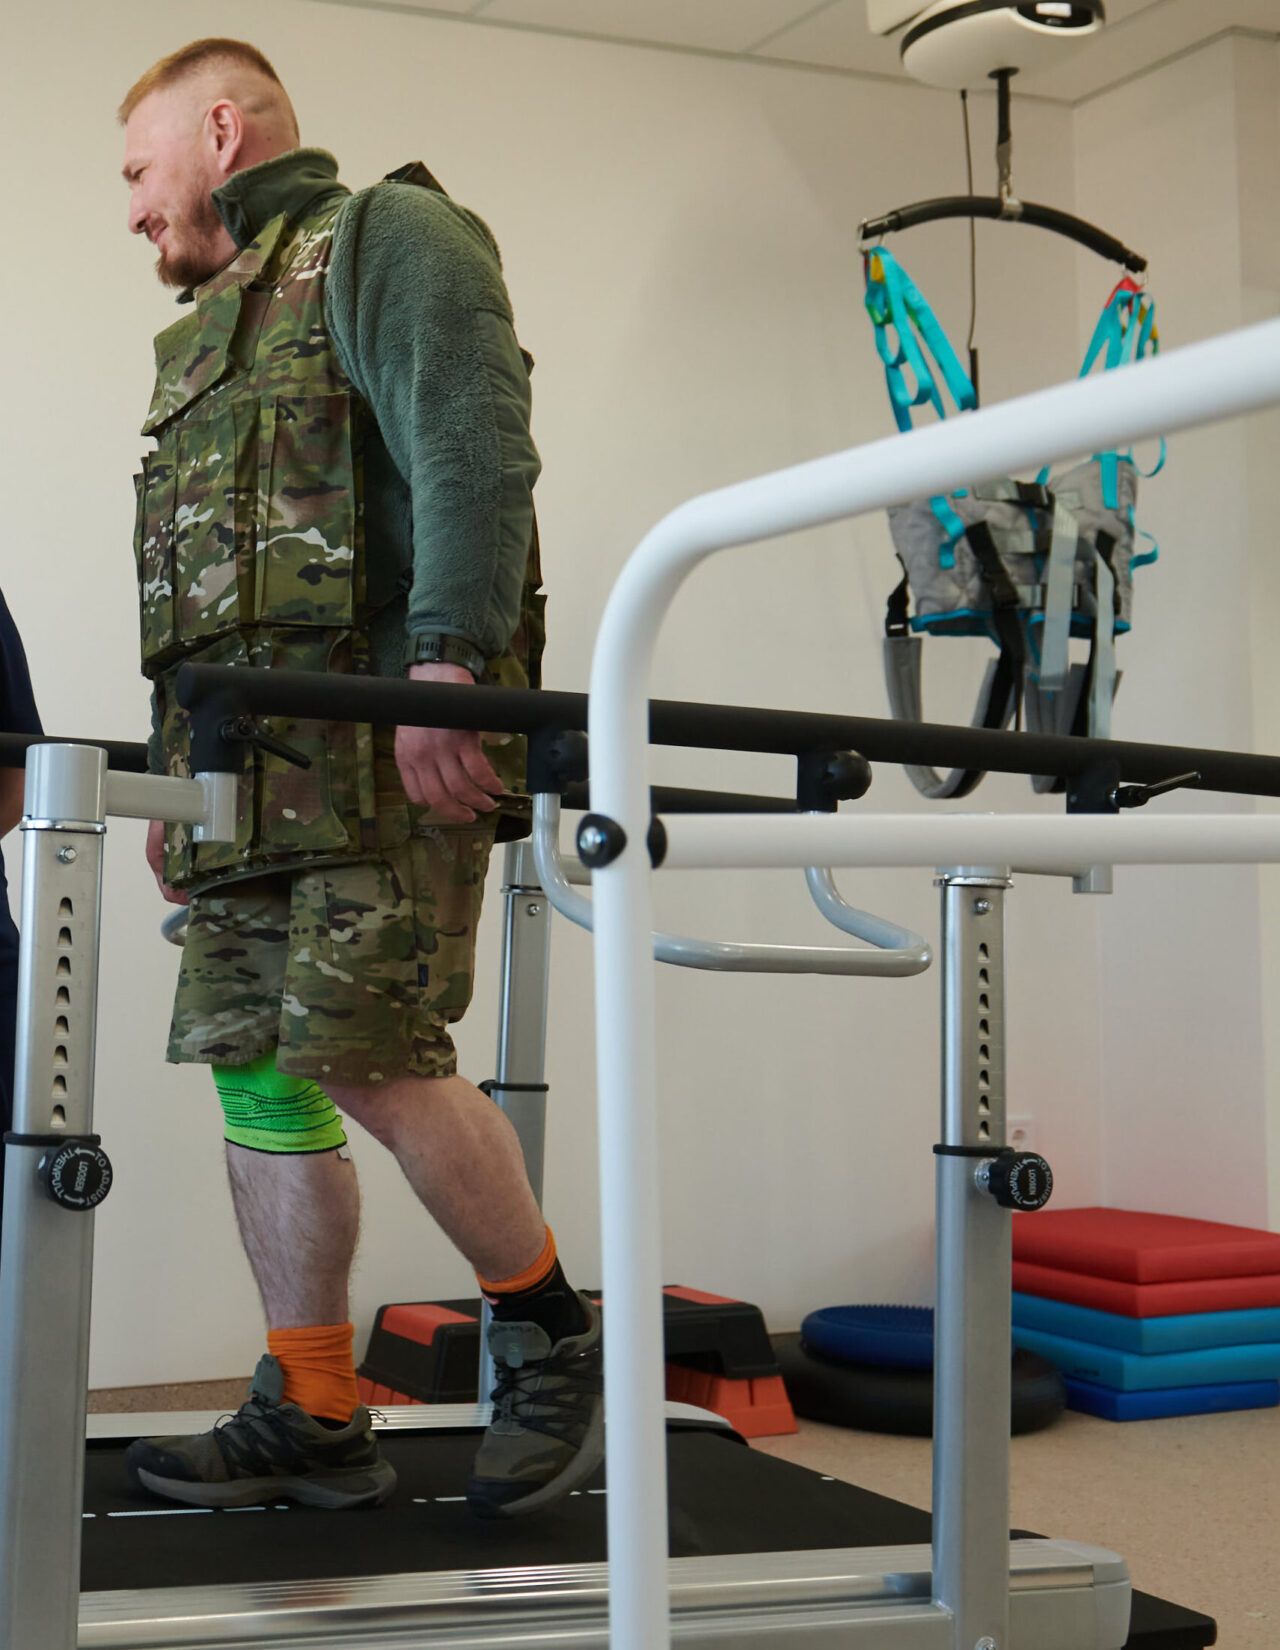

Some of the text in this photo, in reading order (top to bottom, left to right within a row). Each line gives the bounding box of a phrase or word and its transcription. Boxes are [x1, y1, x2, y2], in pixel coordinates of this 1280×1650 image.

[74, 1161, 88, 1192] LOOSEN
[86, 1151, 110, 1206] TO ADJUST
